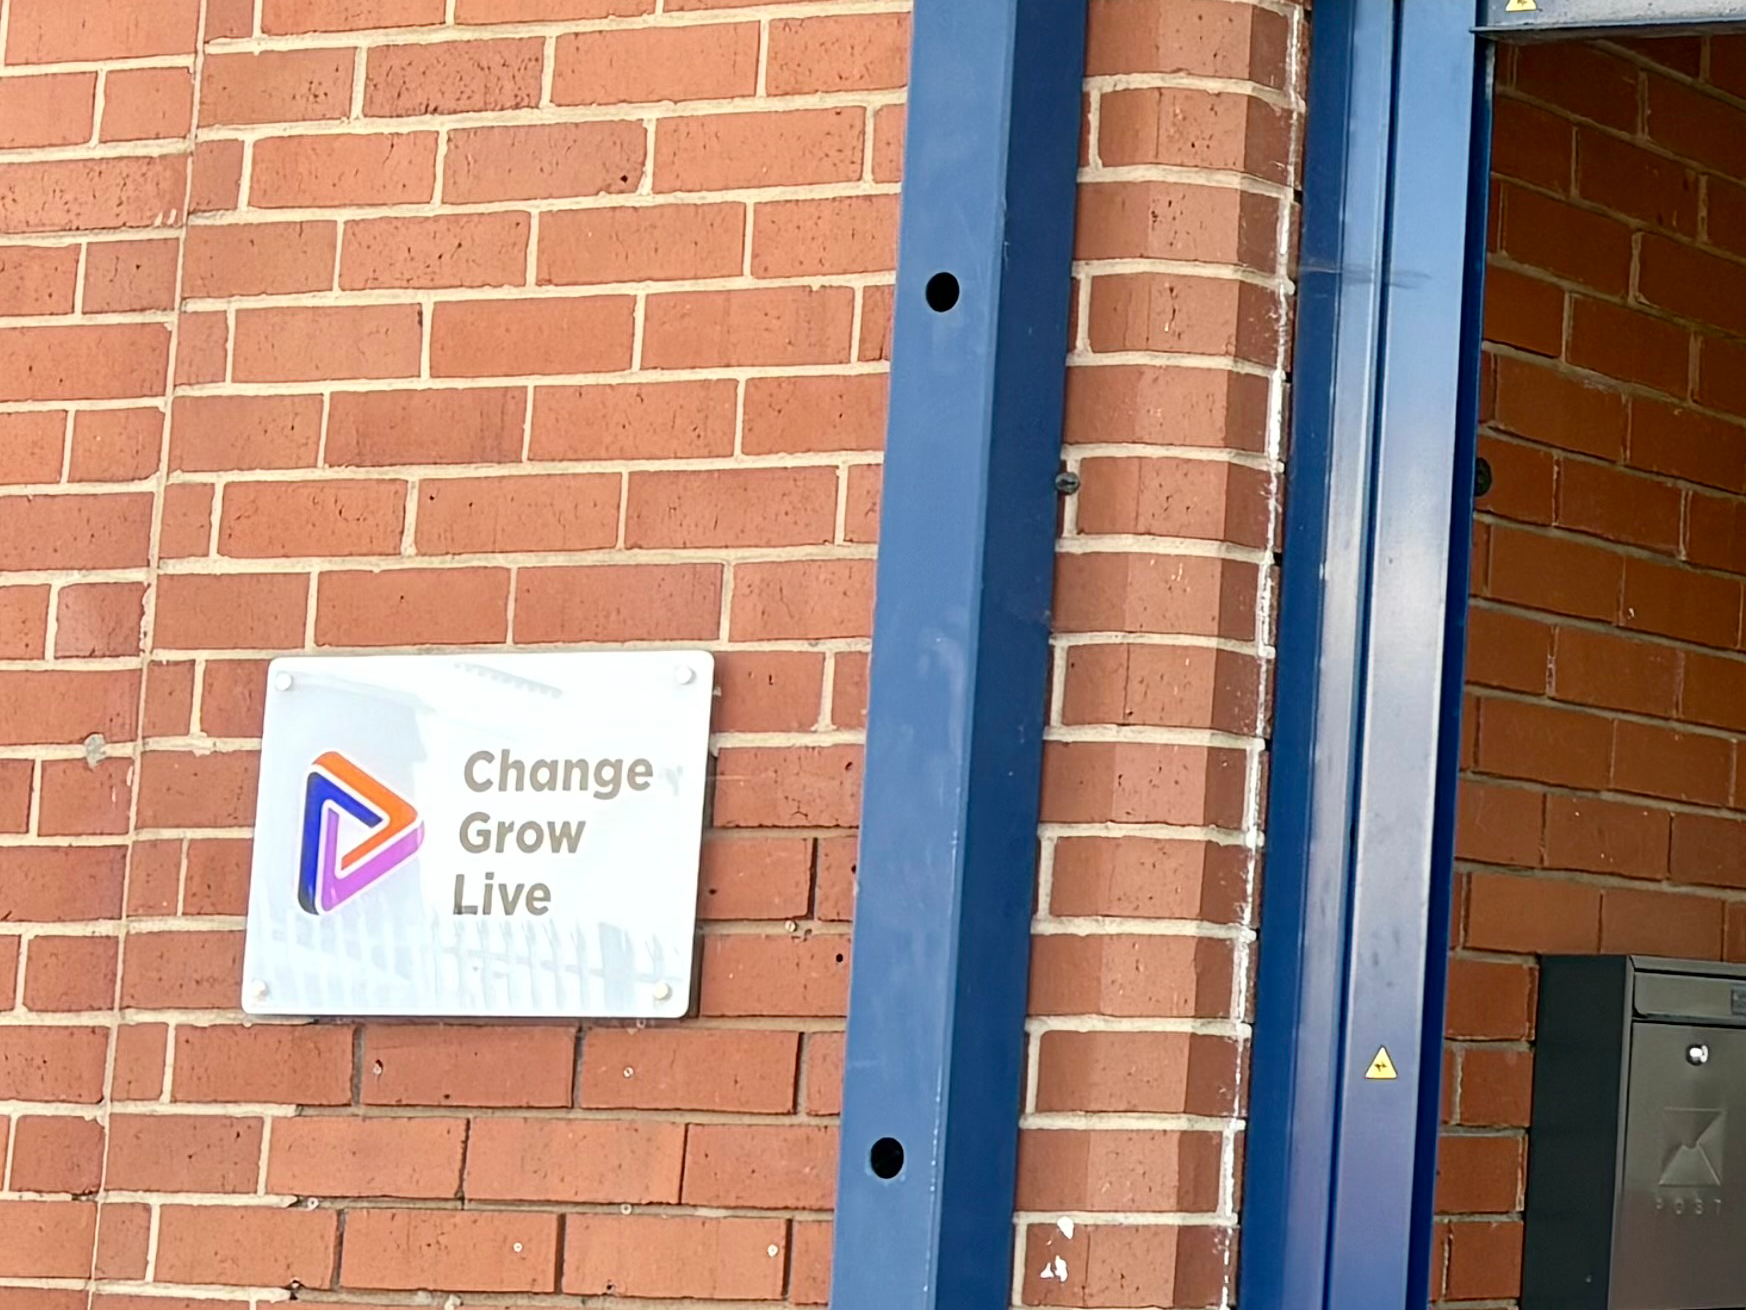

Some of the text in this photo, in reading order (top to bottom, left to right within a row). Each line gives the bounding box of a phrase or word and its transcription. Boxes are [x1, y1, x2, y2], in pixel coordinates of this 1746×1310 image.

[463, 747, 655, 801] Change
[458, 810, 587, 855] Grow
[452, 871, 553, 918] Live
